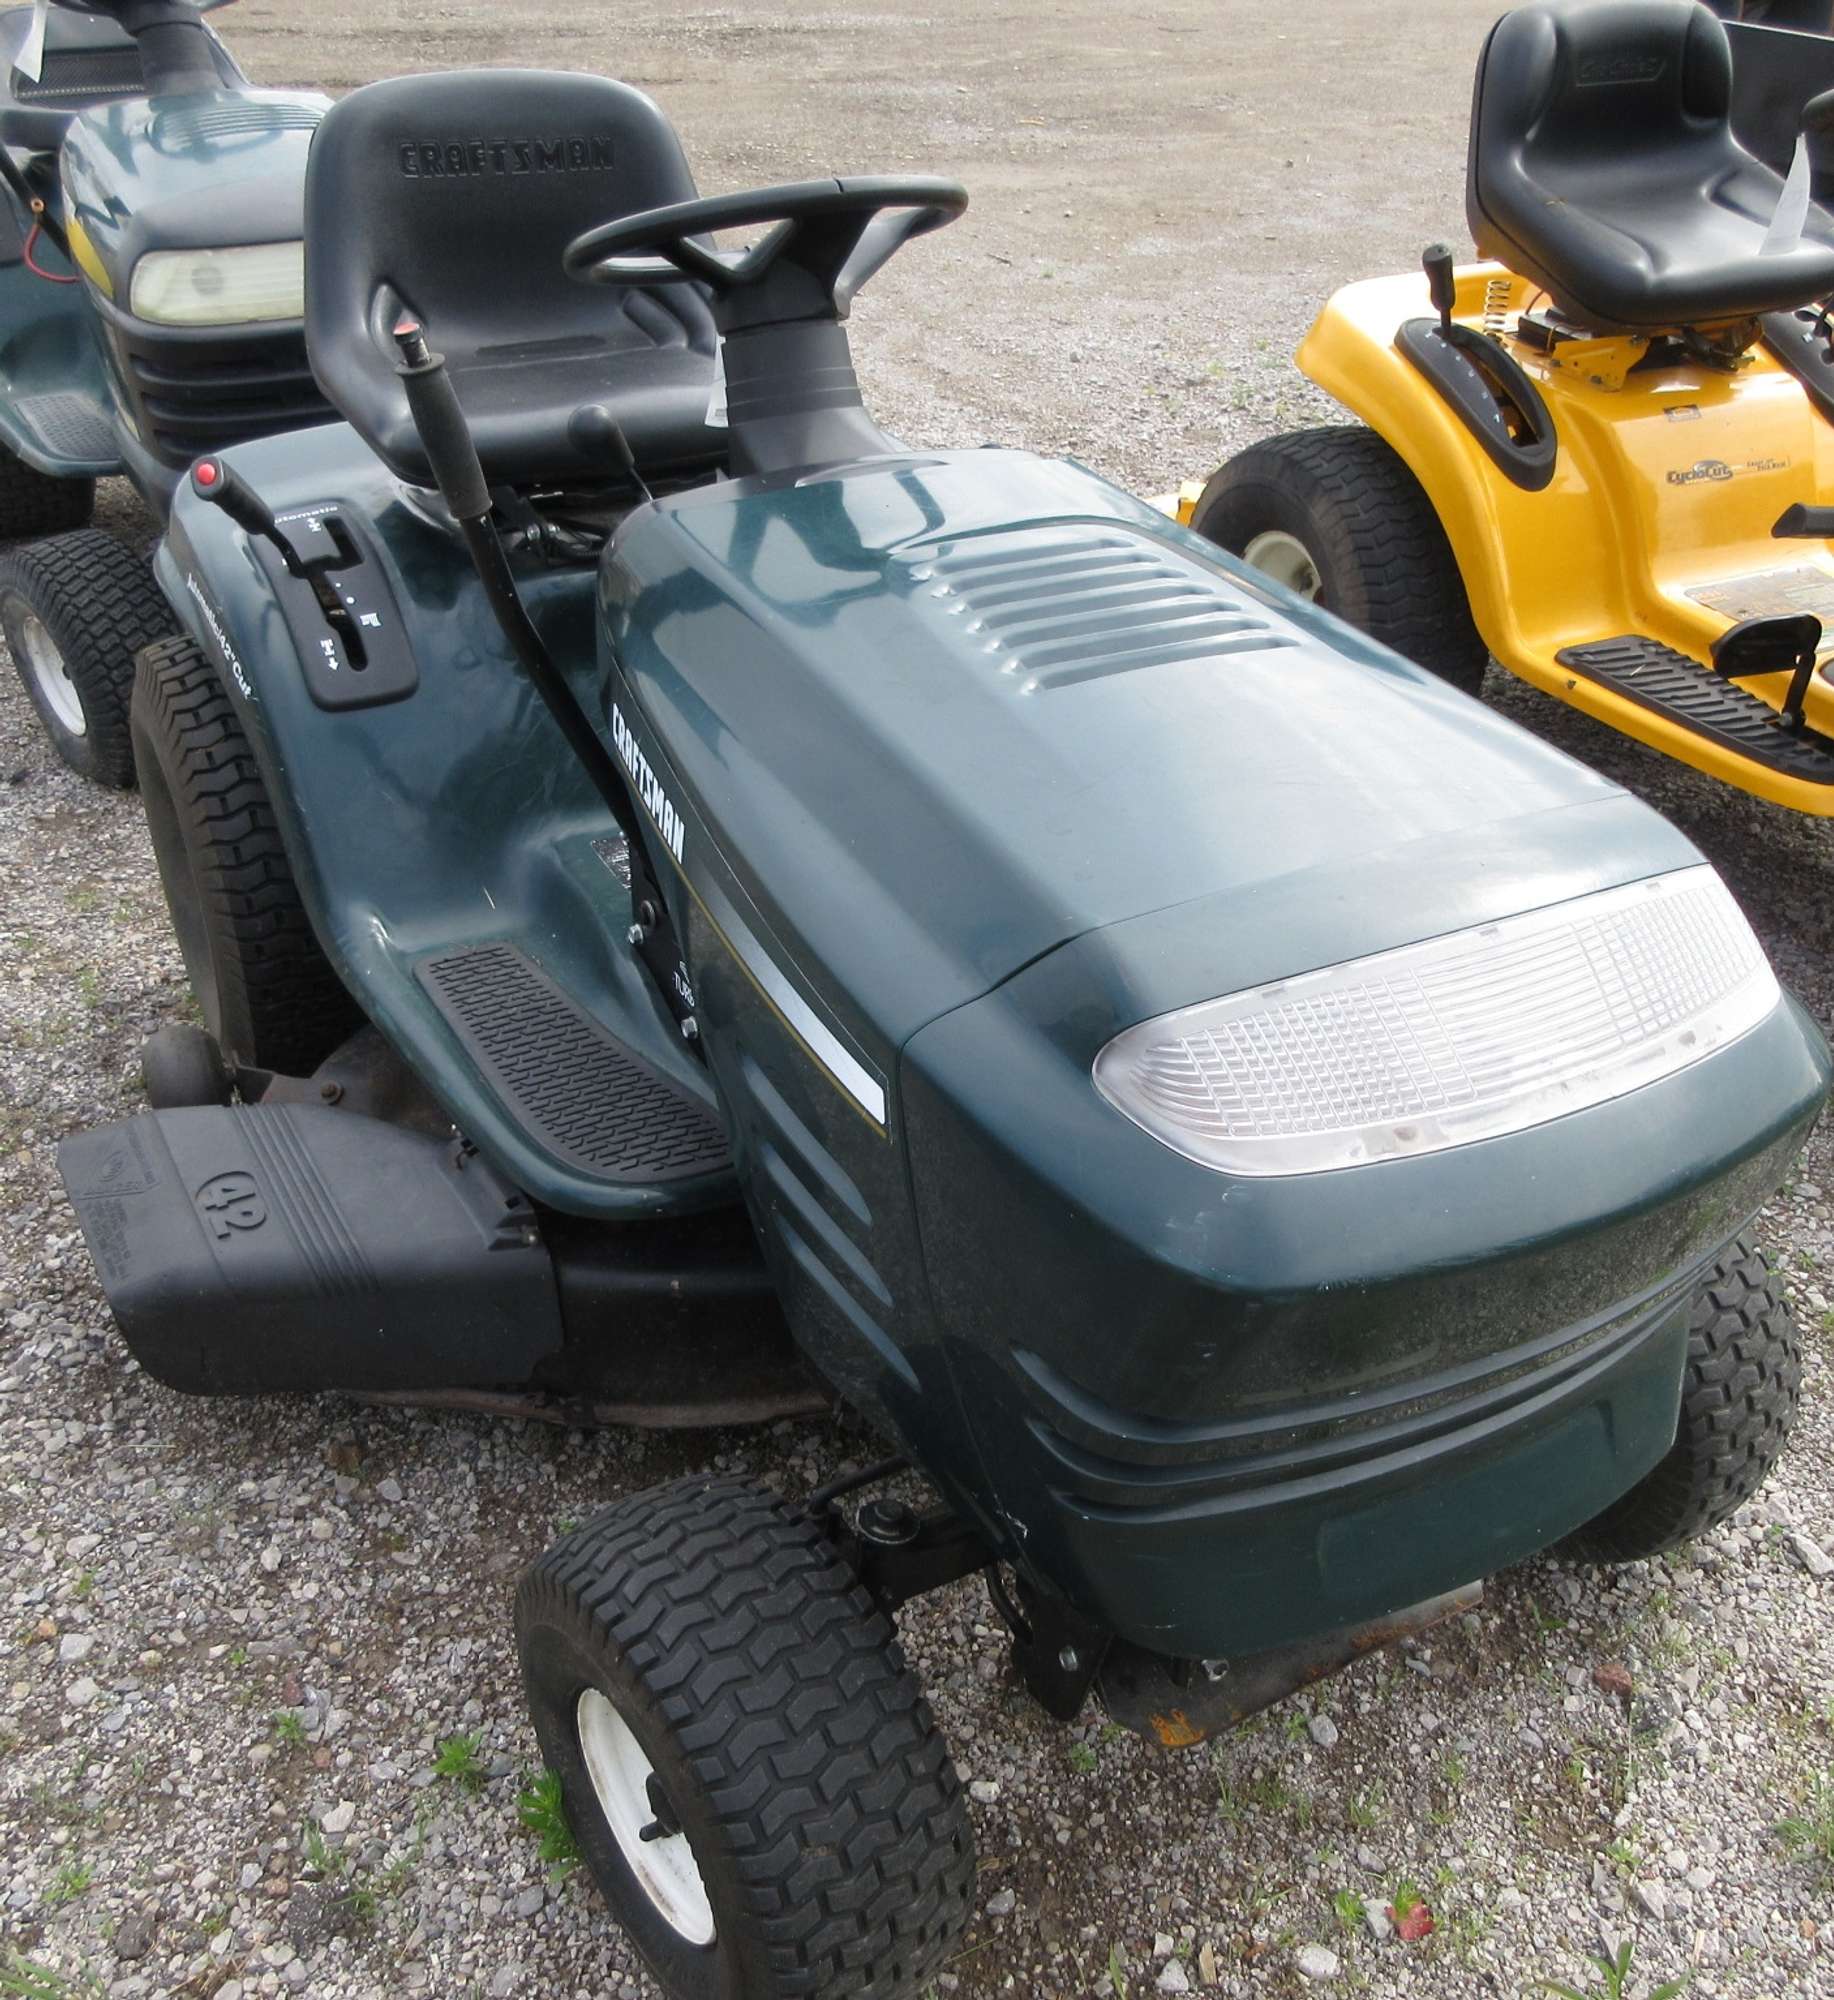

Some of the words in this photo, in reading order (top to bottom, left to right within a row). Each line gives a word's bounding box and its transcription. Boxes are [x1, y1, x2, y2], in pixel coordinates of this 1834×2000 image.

[400, 136, 615, 179] CRAFTSMAN
[275, 506, 338, 524] utomatic
[612, 702, 685, 865] CRAFTSMAN
[196, 1171, 267, 1240] 42
